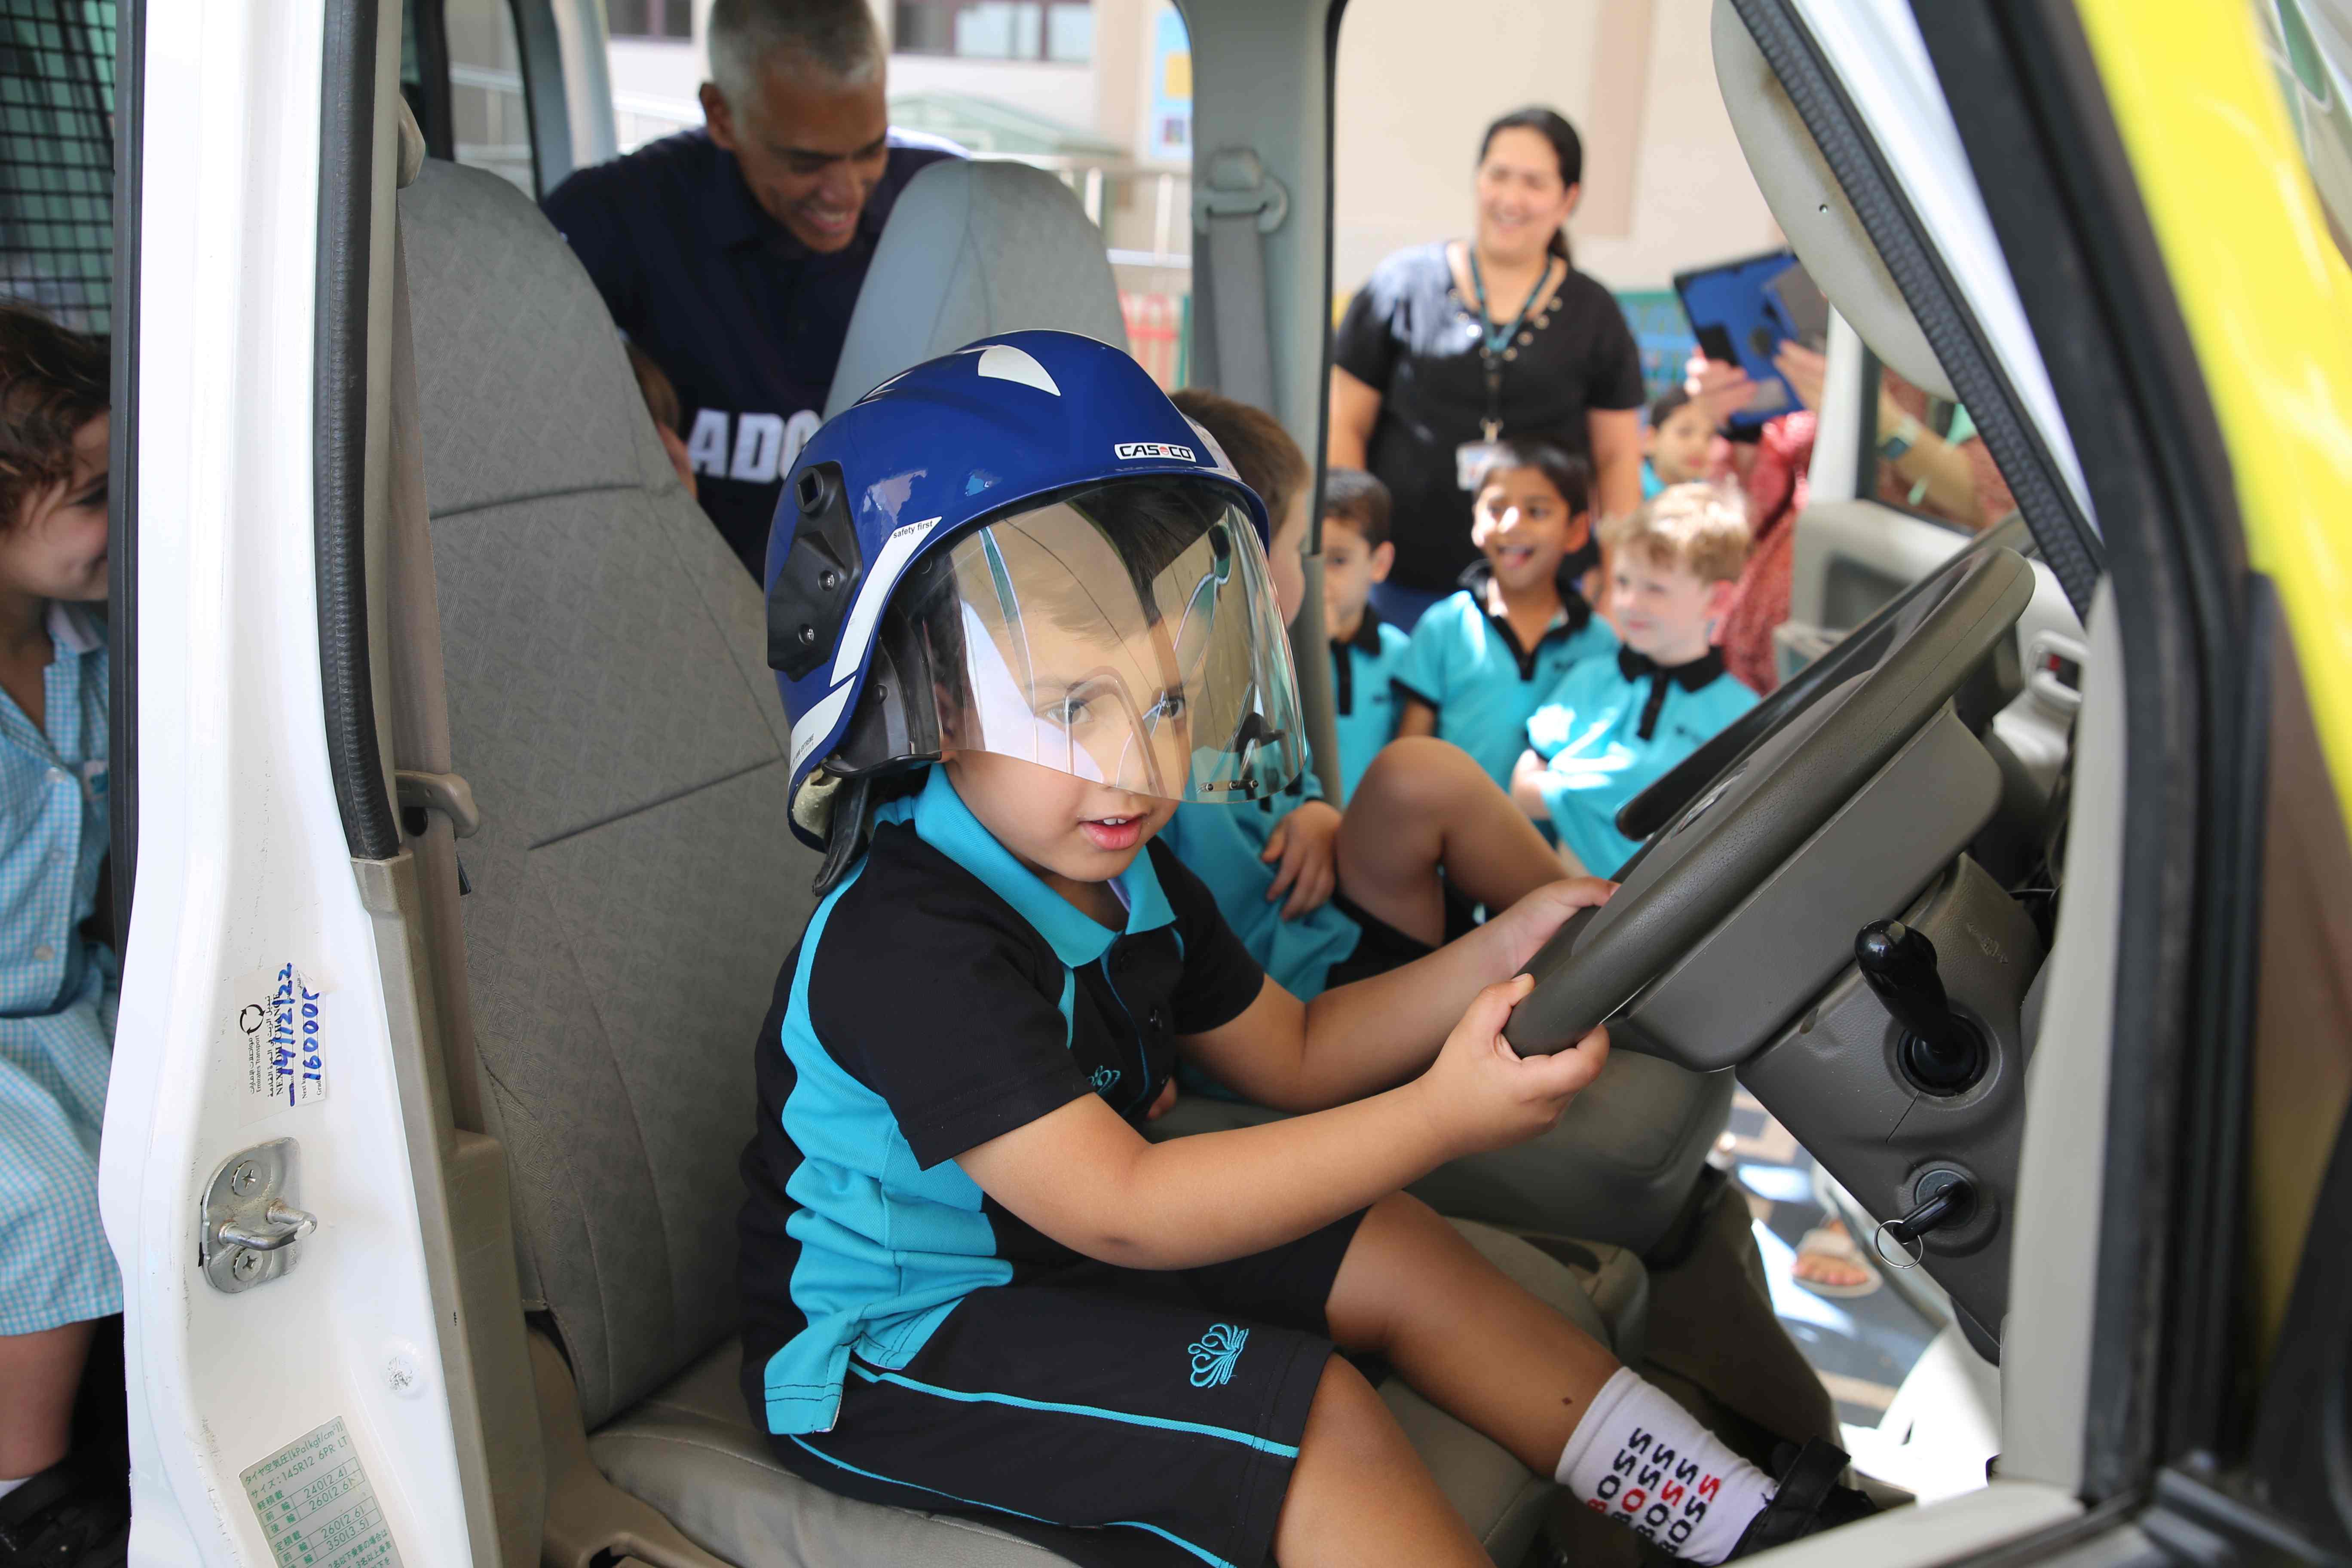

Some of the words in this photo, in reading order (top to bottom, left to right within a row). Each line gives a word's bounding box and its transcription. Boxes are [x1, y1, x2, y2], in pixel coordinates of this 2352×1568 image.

[893, 526, 916, 539] safety
[917, 520, 933, 531] first
[318, 1444, 336, 1460] 6PR
[337, 1436, 348, 1449] LT
[303, 1467, 348, 1499] 240(2.4)
[1587, 1427, 1653, 1513] BOSS
[1611, 1443, 1675, 1524] BOSS
[1635, 1458, 1700, 1539] BOSS
[1658, 1474, 1721, 1556] BOSS
[321, 1506, 365, 1539] 260(2.6)
[326, 1517, 370, 1550] 350(3.5)
